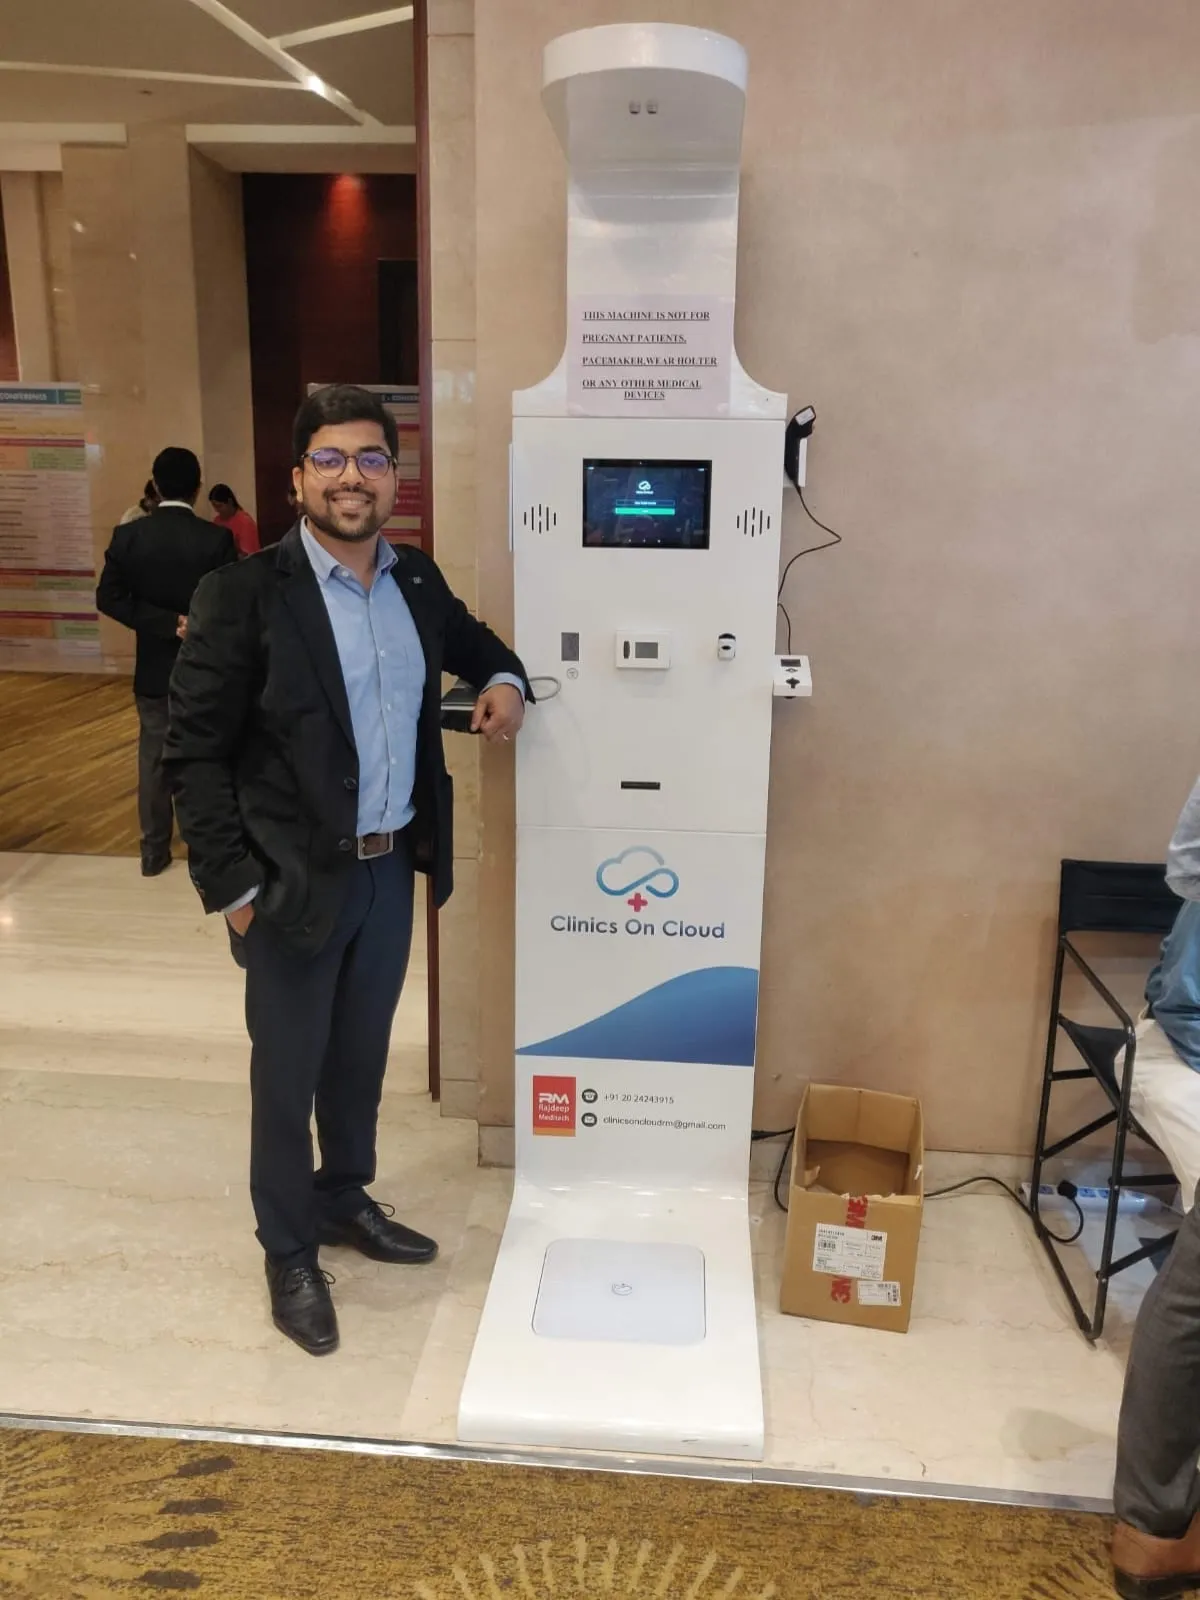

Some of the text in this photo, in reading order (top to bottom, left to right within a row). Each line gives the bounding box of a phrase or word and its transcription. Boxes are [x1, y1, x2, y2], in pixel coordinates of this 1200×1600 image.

[582, 311, 710, 321] THIS MACHINE IS NOT FOR
[582, 334, 635, 344] PREGNANT
[677, 357, 718, 367] HOLTER
[582, 379, 701, 390] OR ANY OTHER MEDICAL
[624, 391, 666, 401] DEVICES
[550, 915, 725, 939] Clinics On Cloud
[603, 1093, 675, 1105] +91 20 24243915
[538, 1104, 570, 1113] Rajdeep
[603, 1115, 726, 1131] clinicsoncloudrm@gmail.com
